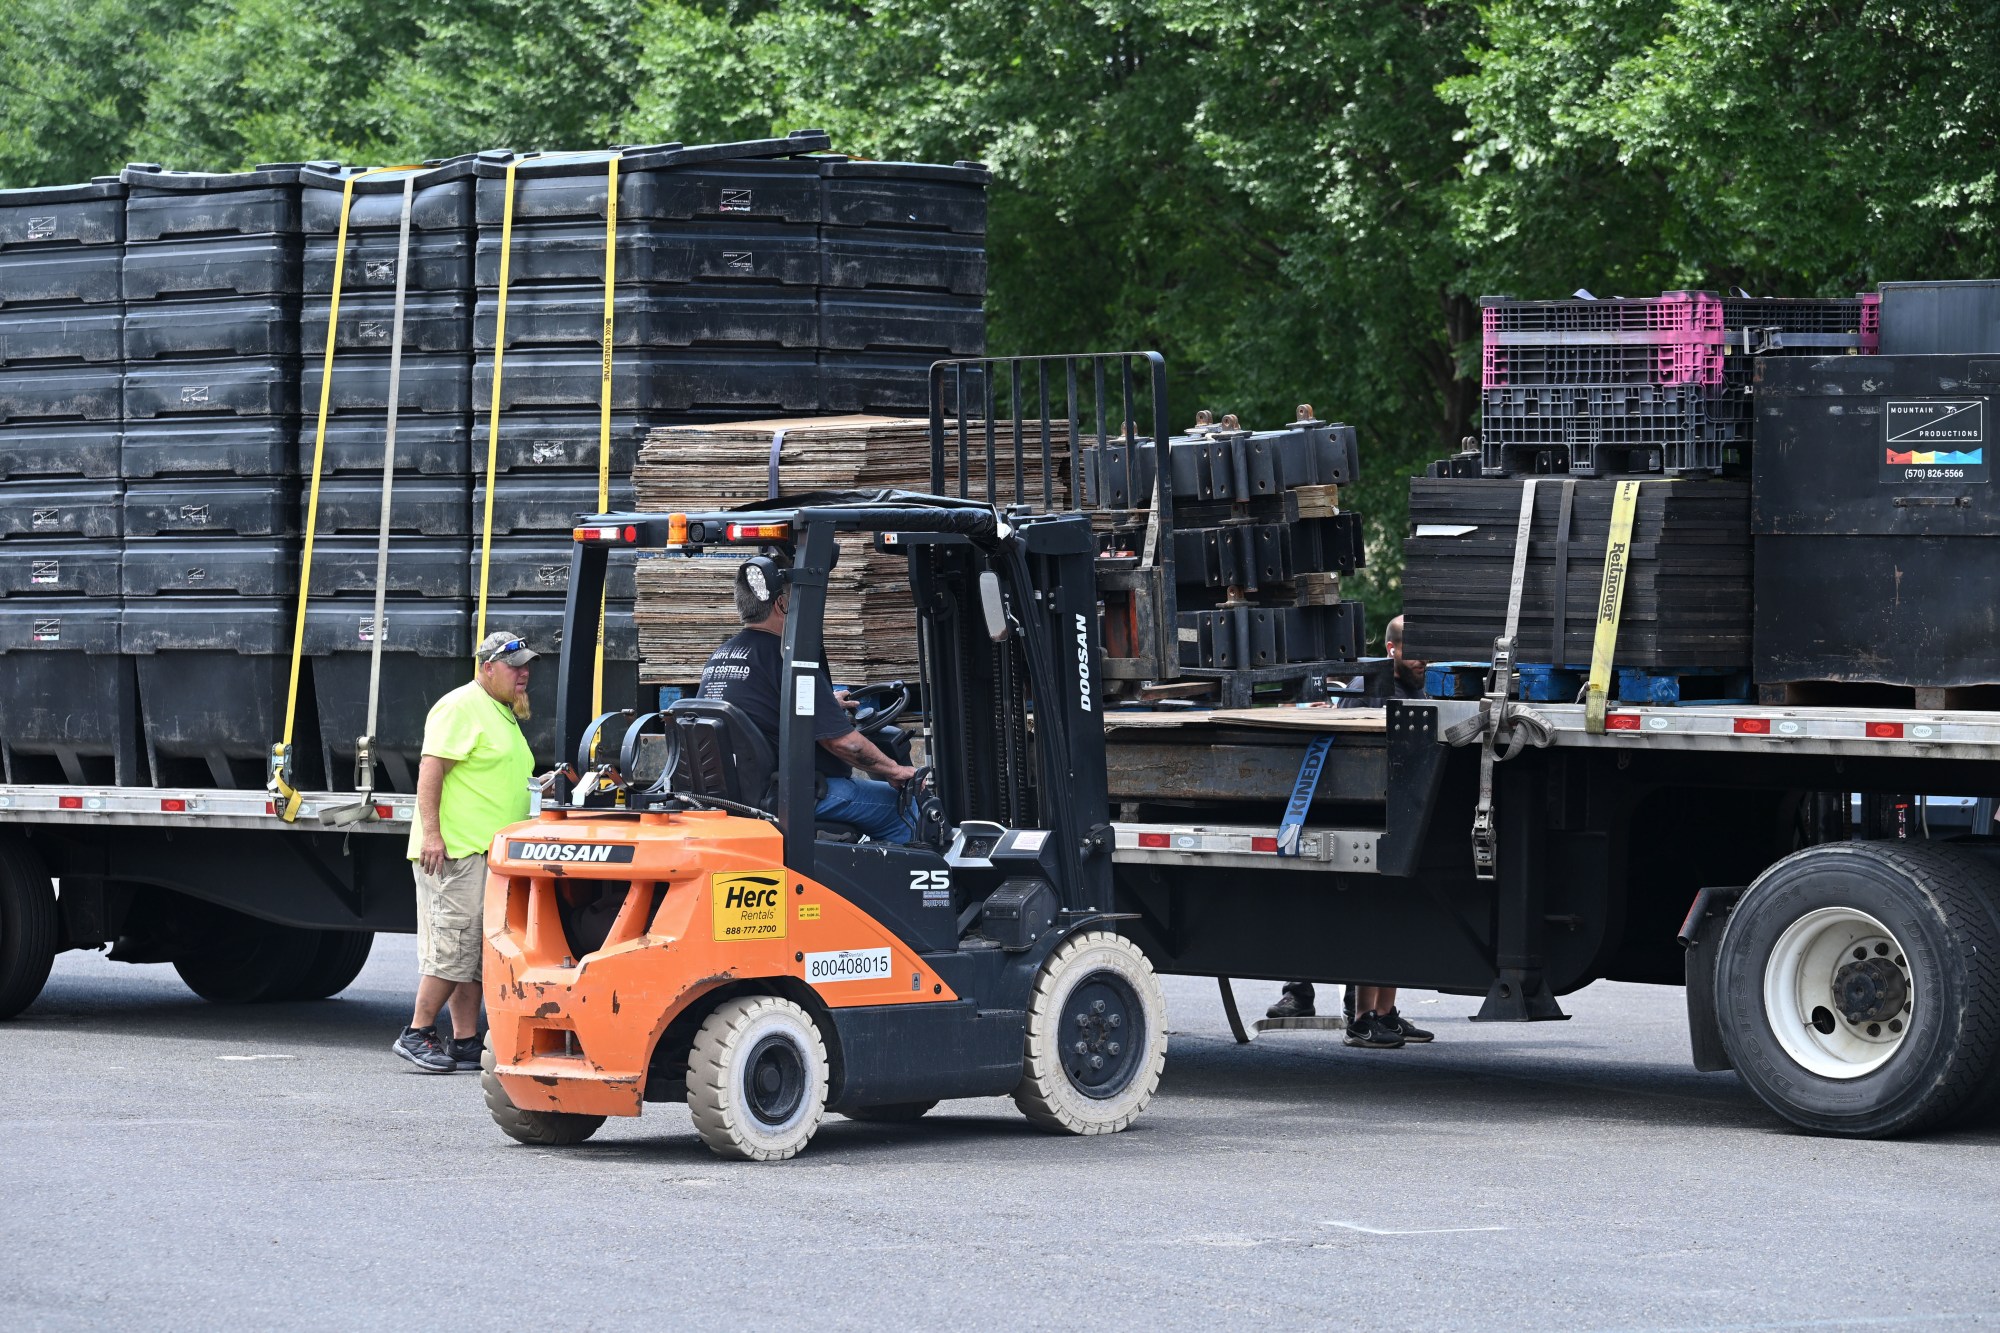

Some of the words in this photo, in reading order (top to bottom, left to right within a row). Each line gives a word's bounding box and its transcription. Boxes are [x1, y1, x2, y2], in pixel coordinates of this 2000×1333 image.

[1904, 468, 1926, 480] (570)
[1927, 469, 1964, 478] 826-5566
[1602, 542, 1626, 622] Reitnouer
[715, 665, 750, 674] COSTELLO
[1075, 613, 1092, 712] DOOSAN
[521, 843, 612, 862] DOOSAN
[910, 870, 950, 890] 25
[725, 886, 778, 908] Herc
[740, 909, 774, 921] Rentals
[812, 956, 888, 977] 800408015
[1901, 919, 1942, 1086] DUNLOP
